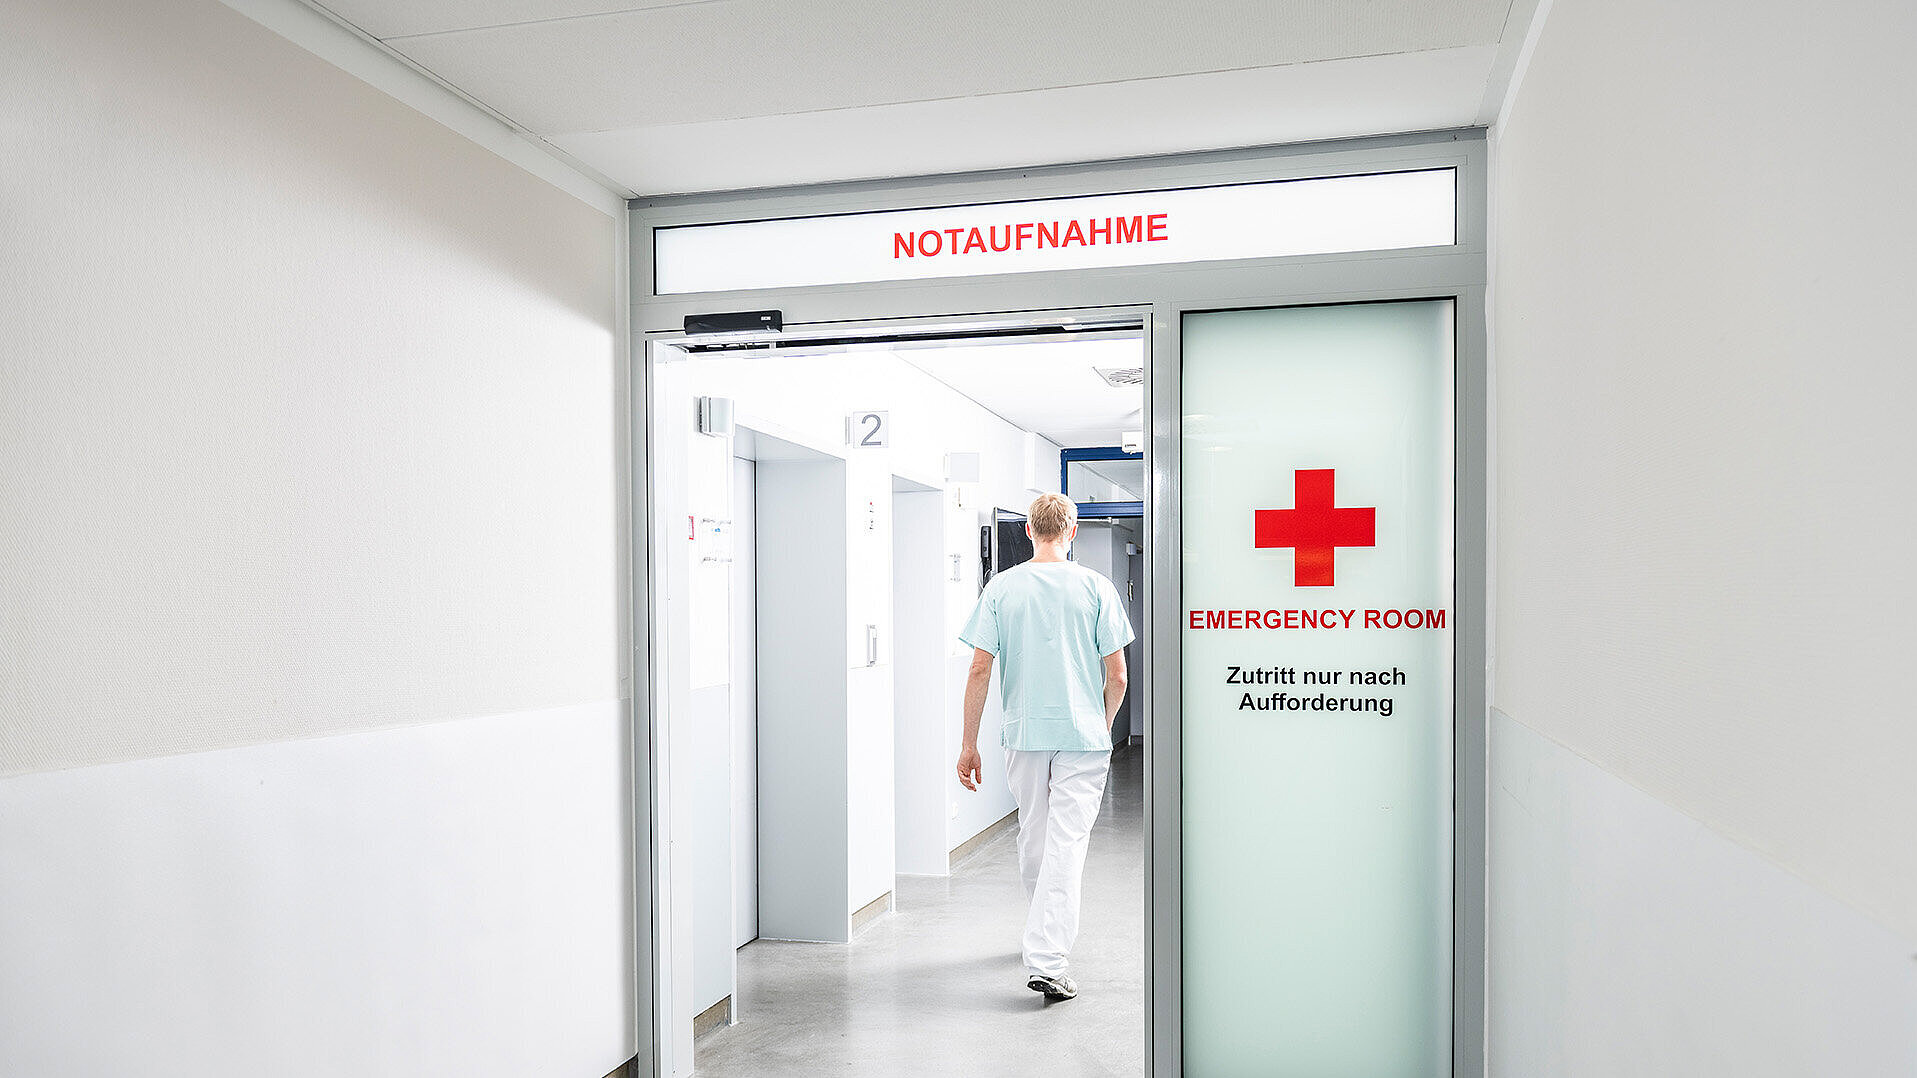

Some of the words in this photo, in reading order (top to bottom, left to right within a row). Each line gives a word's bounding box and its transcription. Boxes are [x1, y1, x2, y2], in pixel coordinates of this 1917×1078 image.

[893, 213, 1169, 260] NOTAUFNAHME
[861, 414, 882, 446] 2
[1189, 609, 1356, 630] EMERGENCY
[1364, 609, 1446, 630] ROOM
[1226, 666, 1296, 685] Zutritt
[1303, 671, 1342, 685] nur
[1349, 667, 1406, 686] nach
[1238, 693, 1393, 717] Aufforderung
